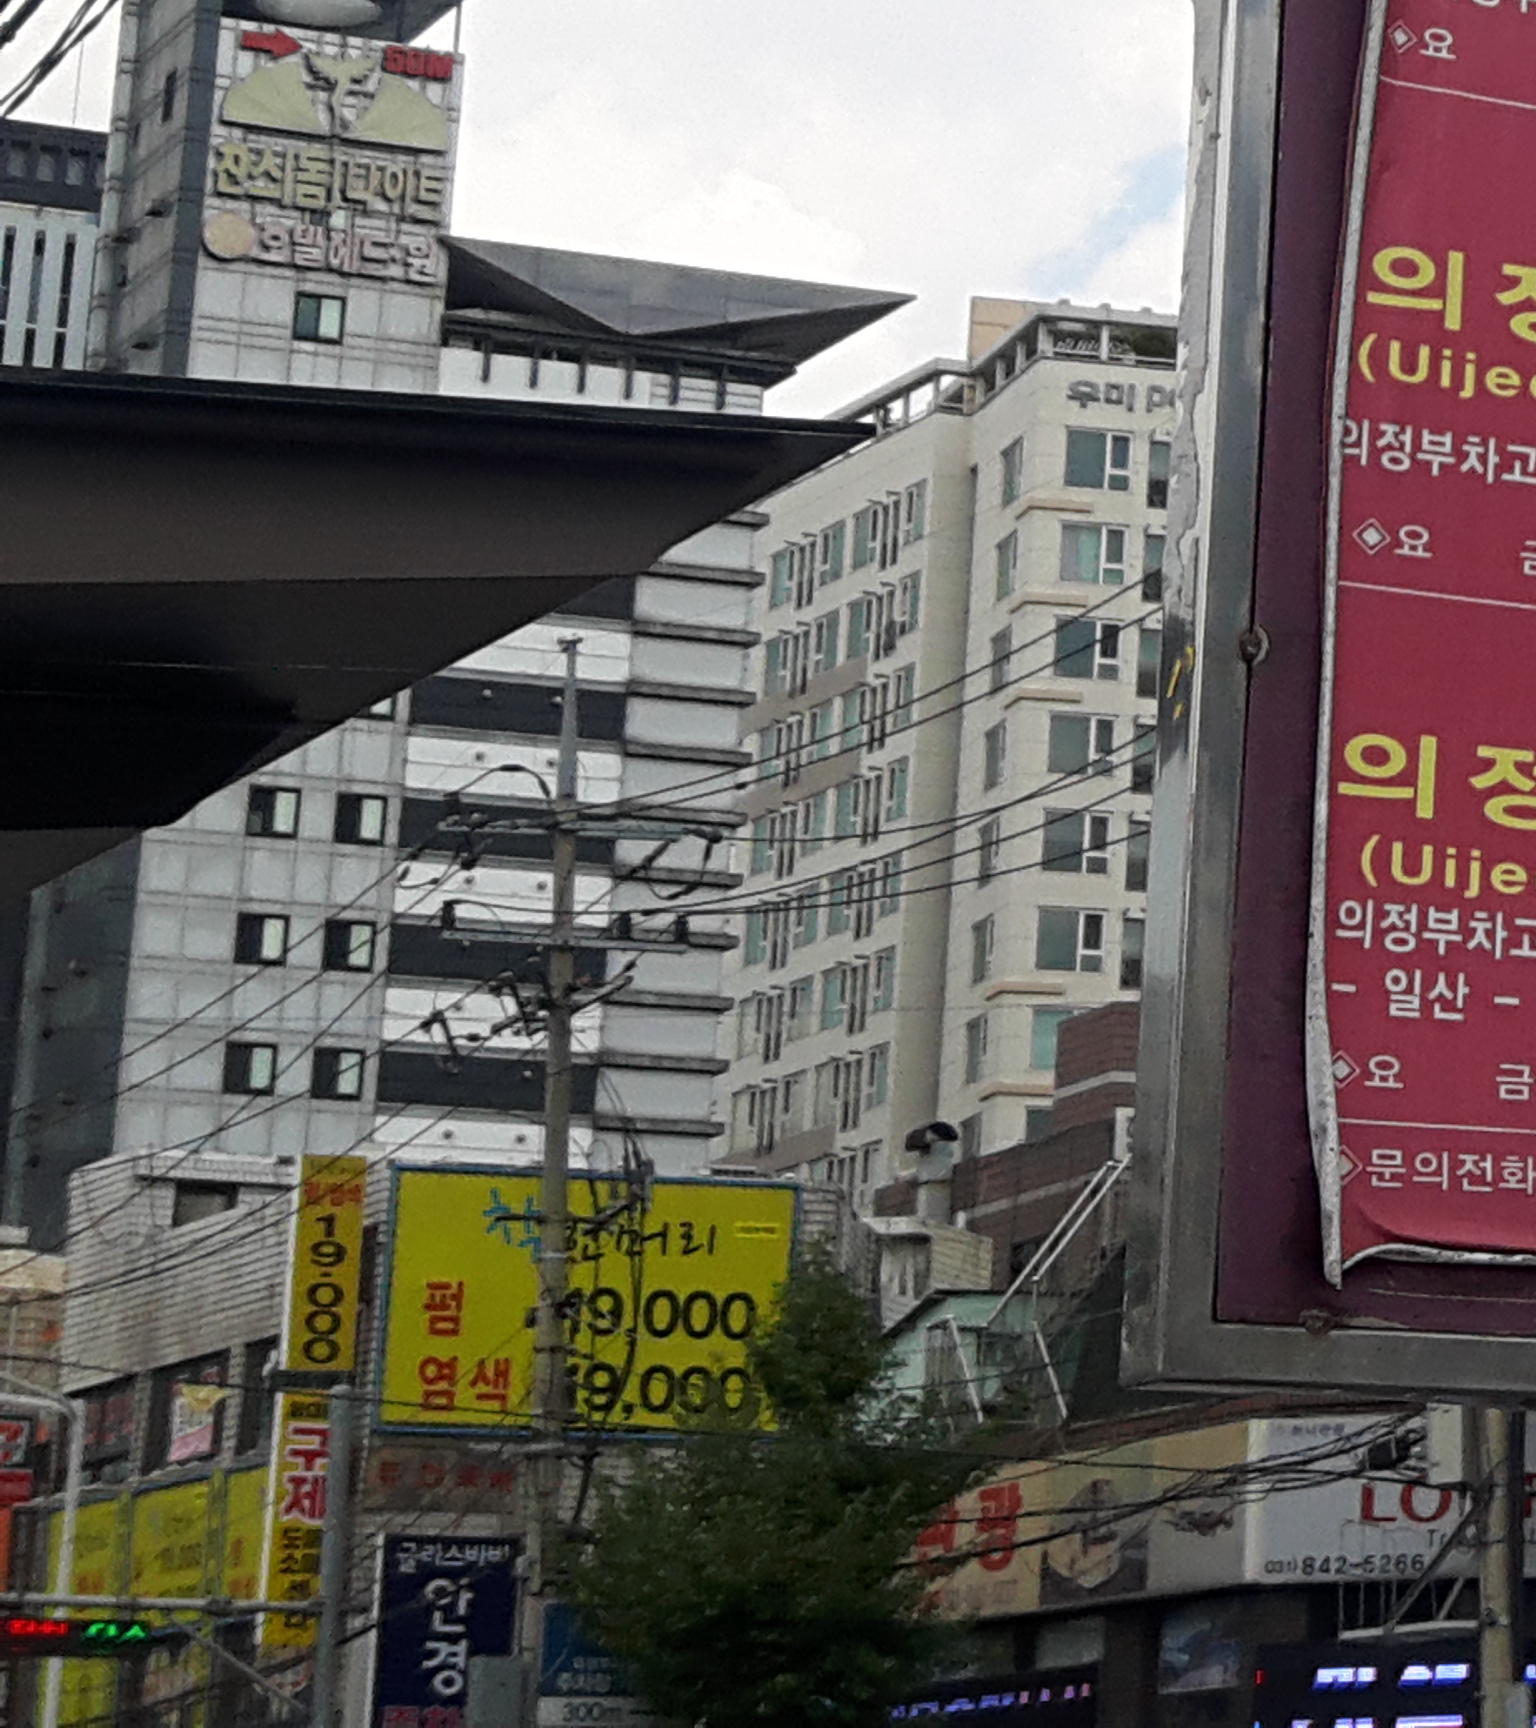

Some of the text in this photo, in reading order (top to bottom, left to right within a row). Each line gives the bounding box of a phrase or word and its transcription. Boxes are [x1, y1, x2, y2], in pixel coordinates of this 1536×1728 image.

[1419, 26, 1458, 61] 요
[1394, 524, 1433, 560] 요
[1383, 967, 1470, 1022] 일산
[1364, 1055, 1405, 1090] 요
